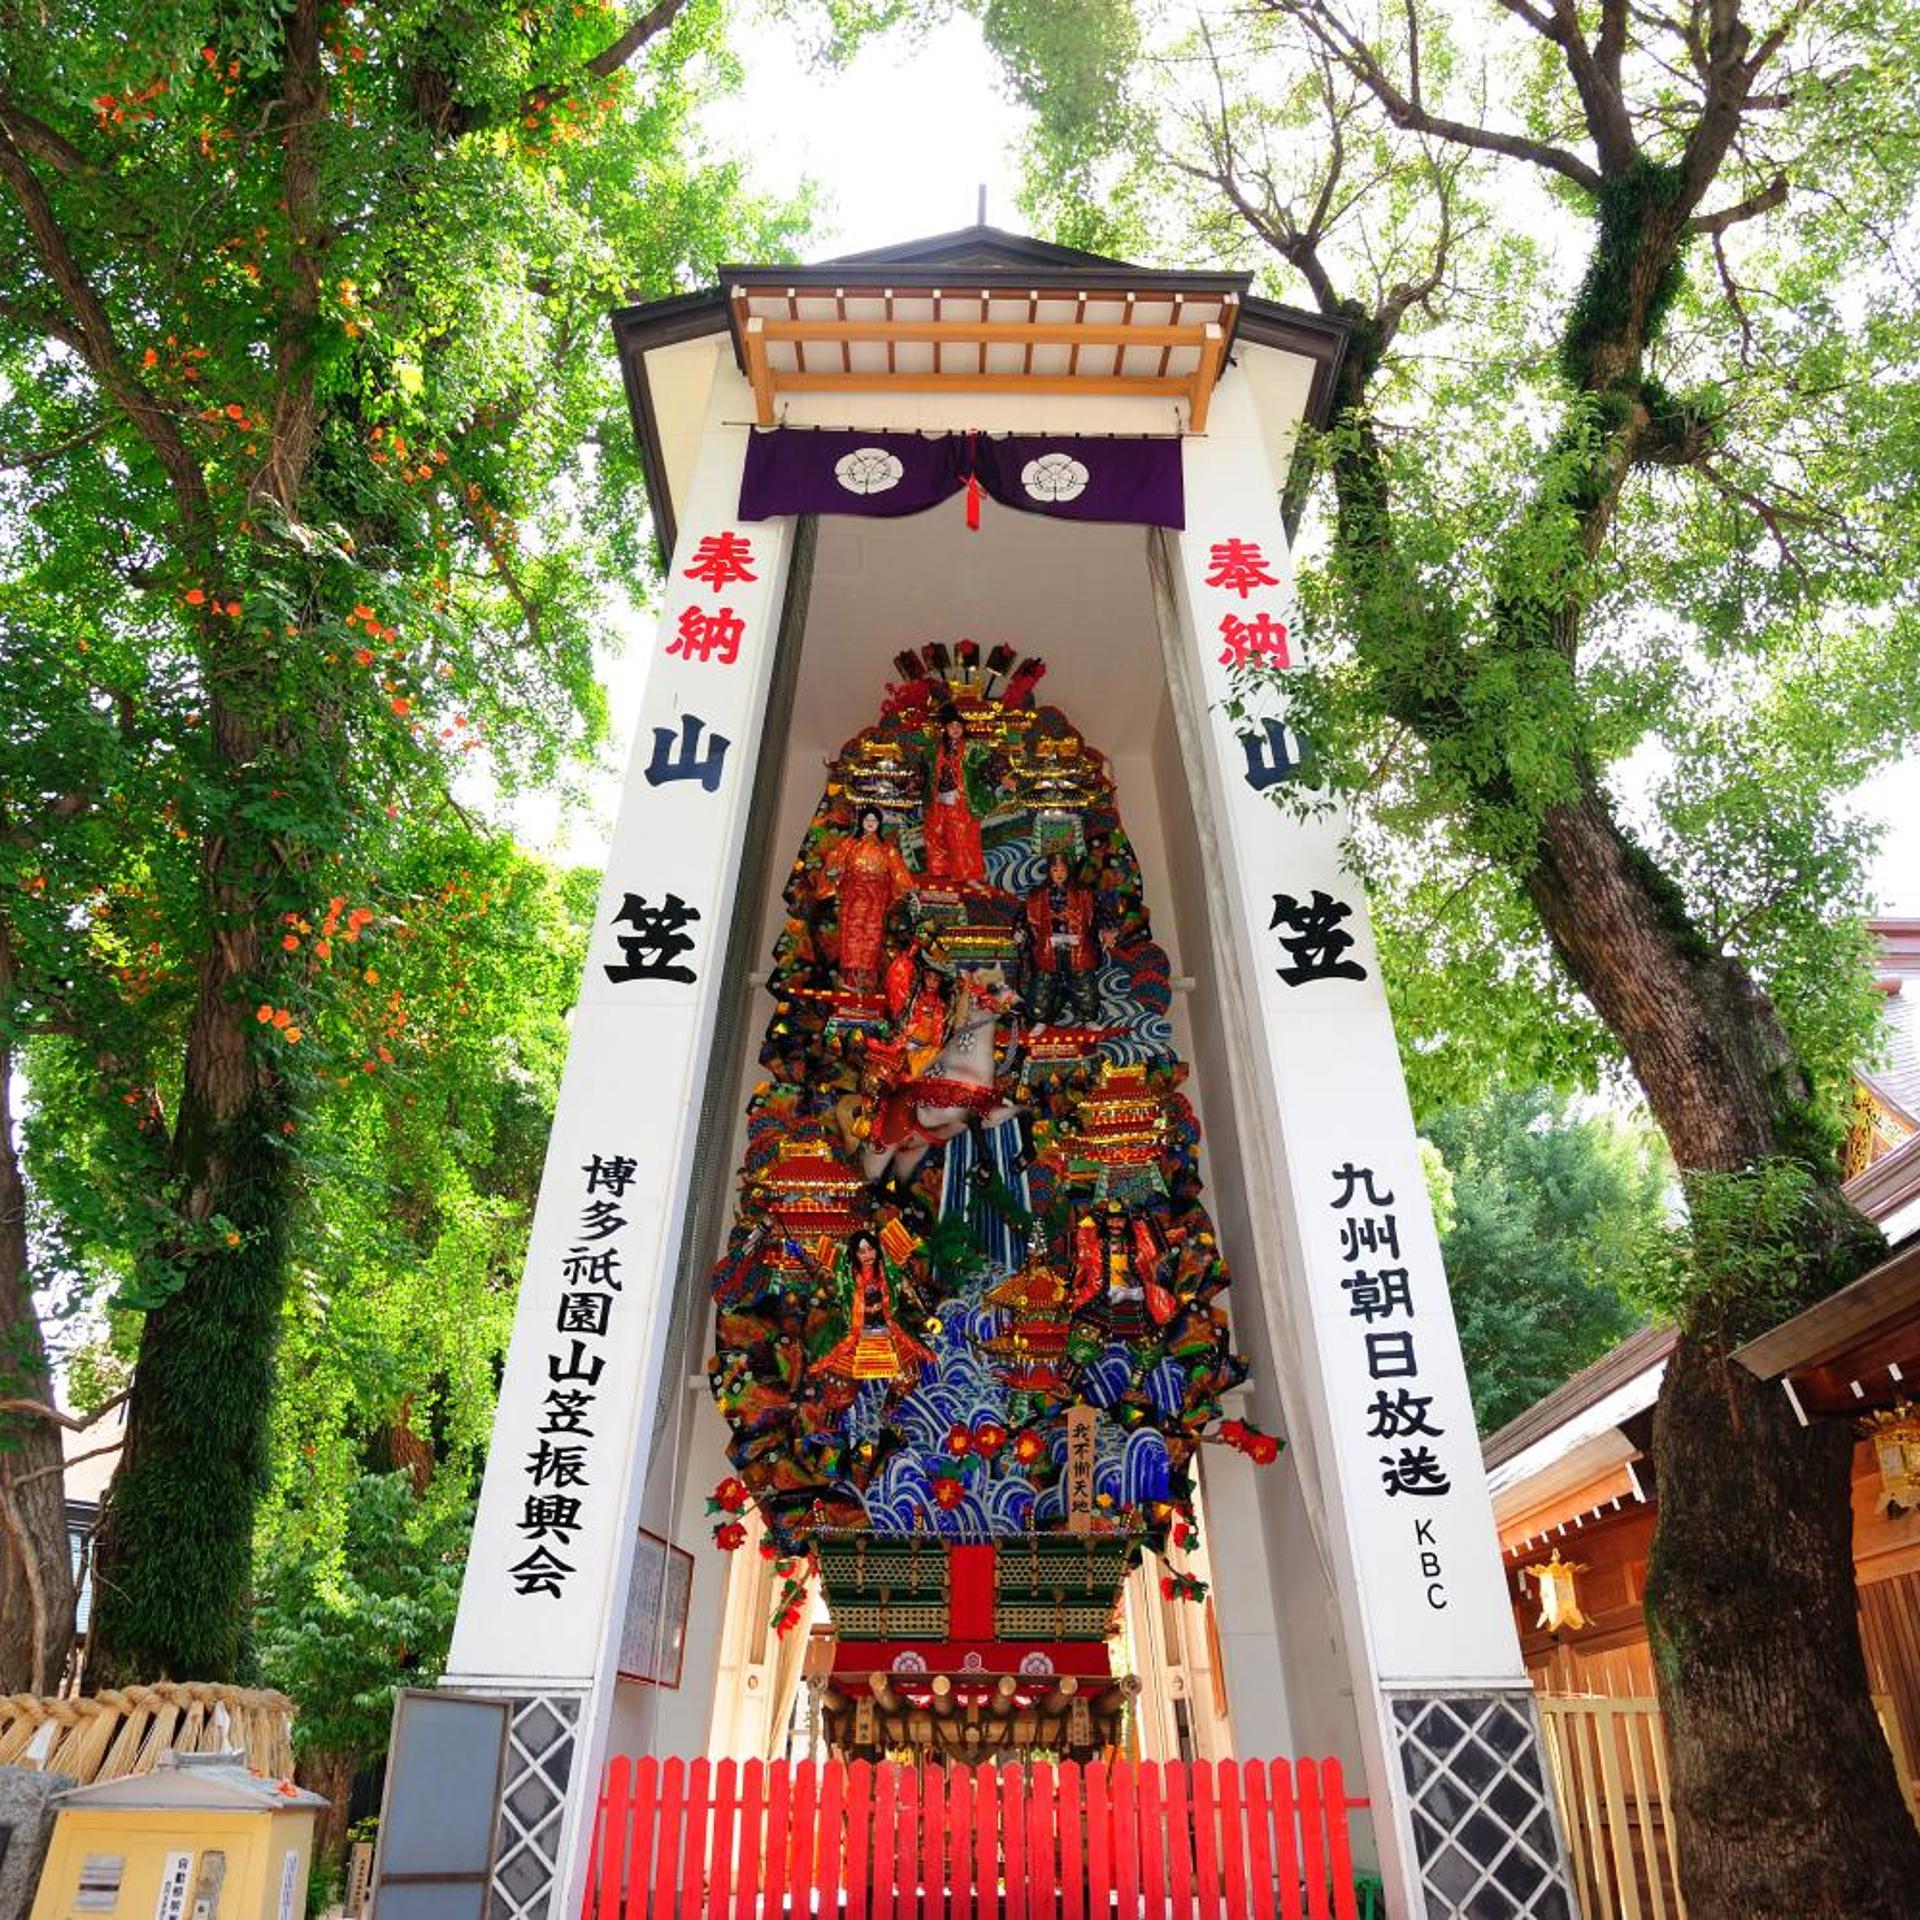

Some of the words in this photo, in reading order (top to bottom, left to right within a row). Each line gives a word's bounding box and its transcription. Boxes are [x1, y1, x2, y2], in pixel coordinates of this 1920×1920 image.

[603, 530, 758, 985] 奉納山笠
[507, 1153, 638, 1600] 博多祇園山笠振興会
[1330, 1162, 1452, 1498] 九州朝日放送
[1415, 1518, 1448, 1611] KBC
